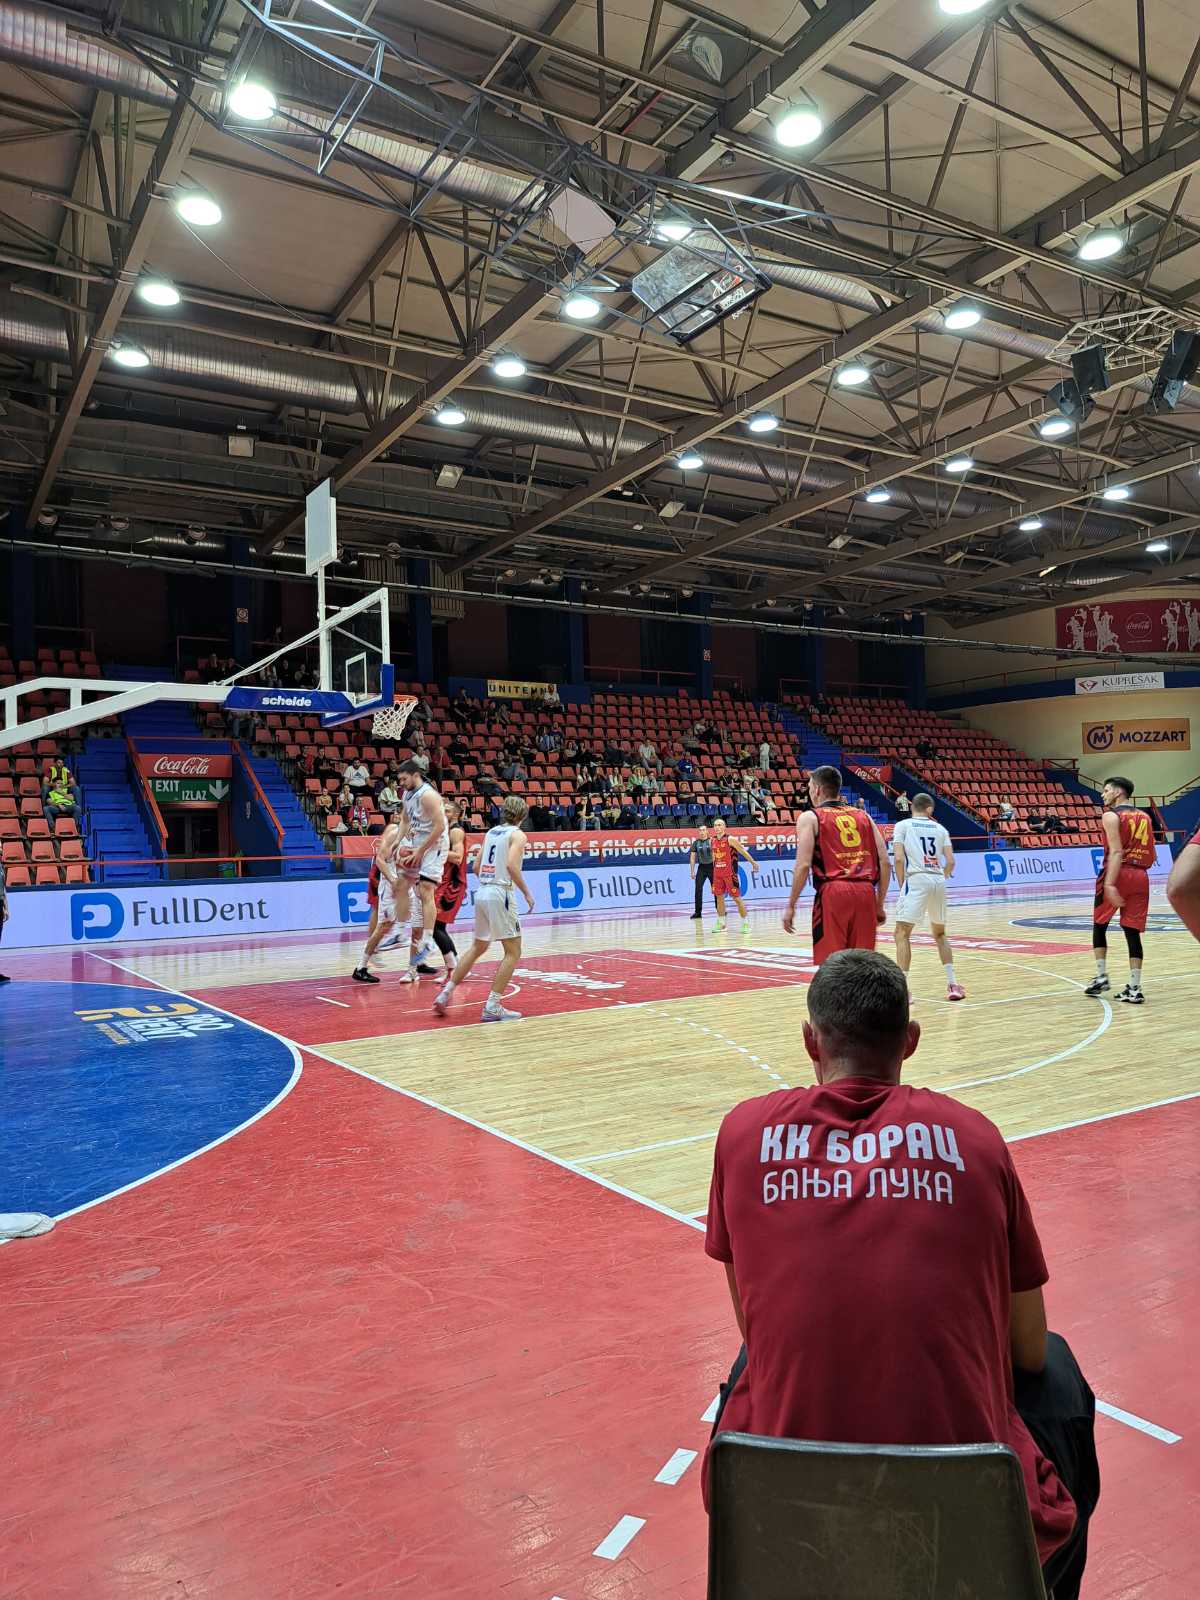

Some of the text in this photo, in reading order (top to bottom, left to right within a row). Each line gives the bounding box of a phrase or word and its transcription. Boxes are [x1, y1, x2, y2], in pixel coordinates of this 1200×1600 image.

[1119, 731, 1186, 743] MOZZART
[155, 780, 180, 793] EXIT
[181, 790, 207, 801] IZLAZ
[755, 834, 800, 851] БОРА
[835, 815, 861, 848] 8
[1128, 818, 1148, 846] 14
[919, 836, 936, 856] 13
[1009, 854, 1065, 875] FullDent
[587, 875, 675, 898] FullDent
[132, 898, 270, 927] FullDent
[760, 1122, 966, 1172] КК БОРАЦ
[763, 1167, 953, 1204] БАЊА ЛУКА
